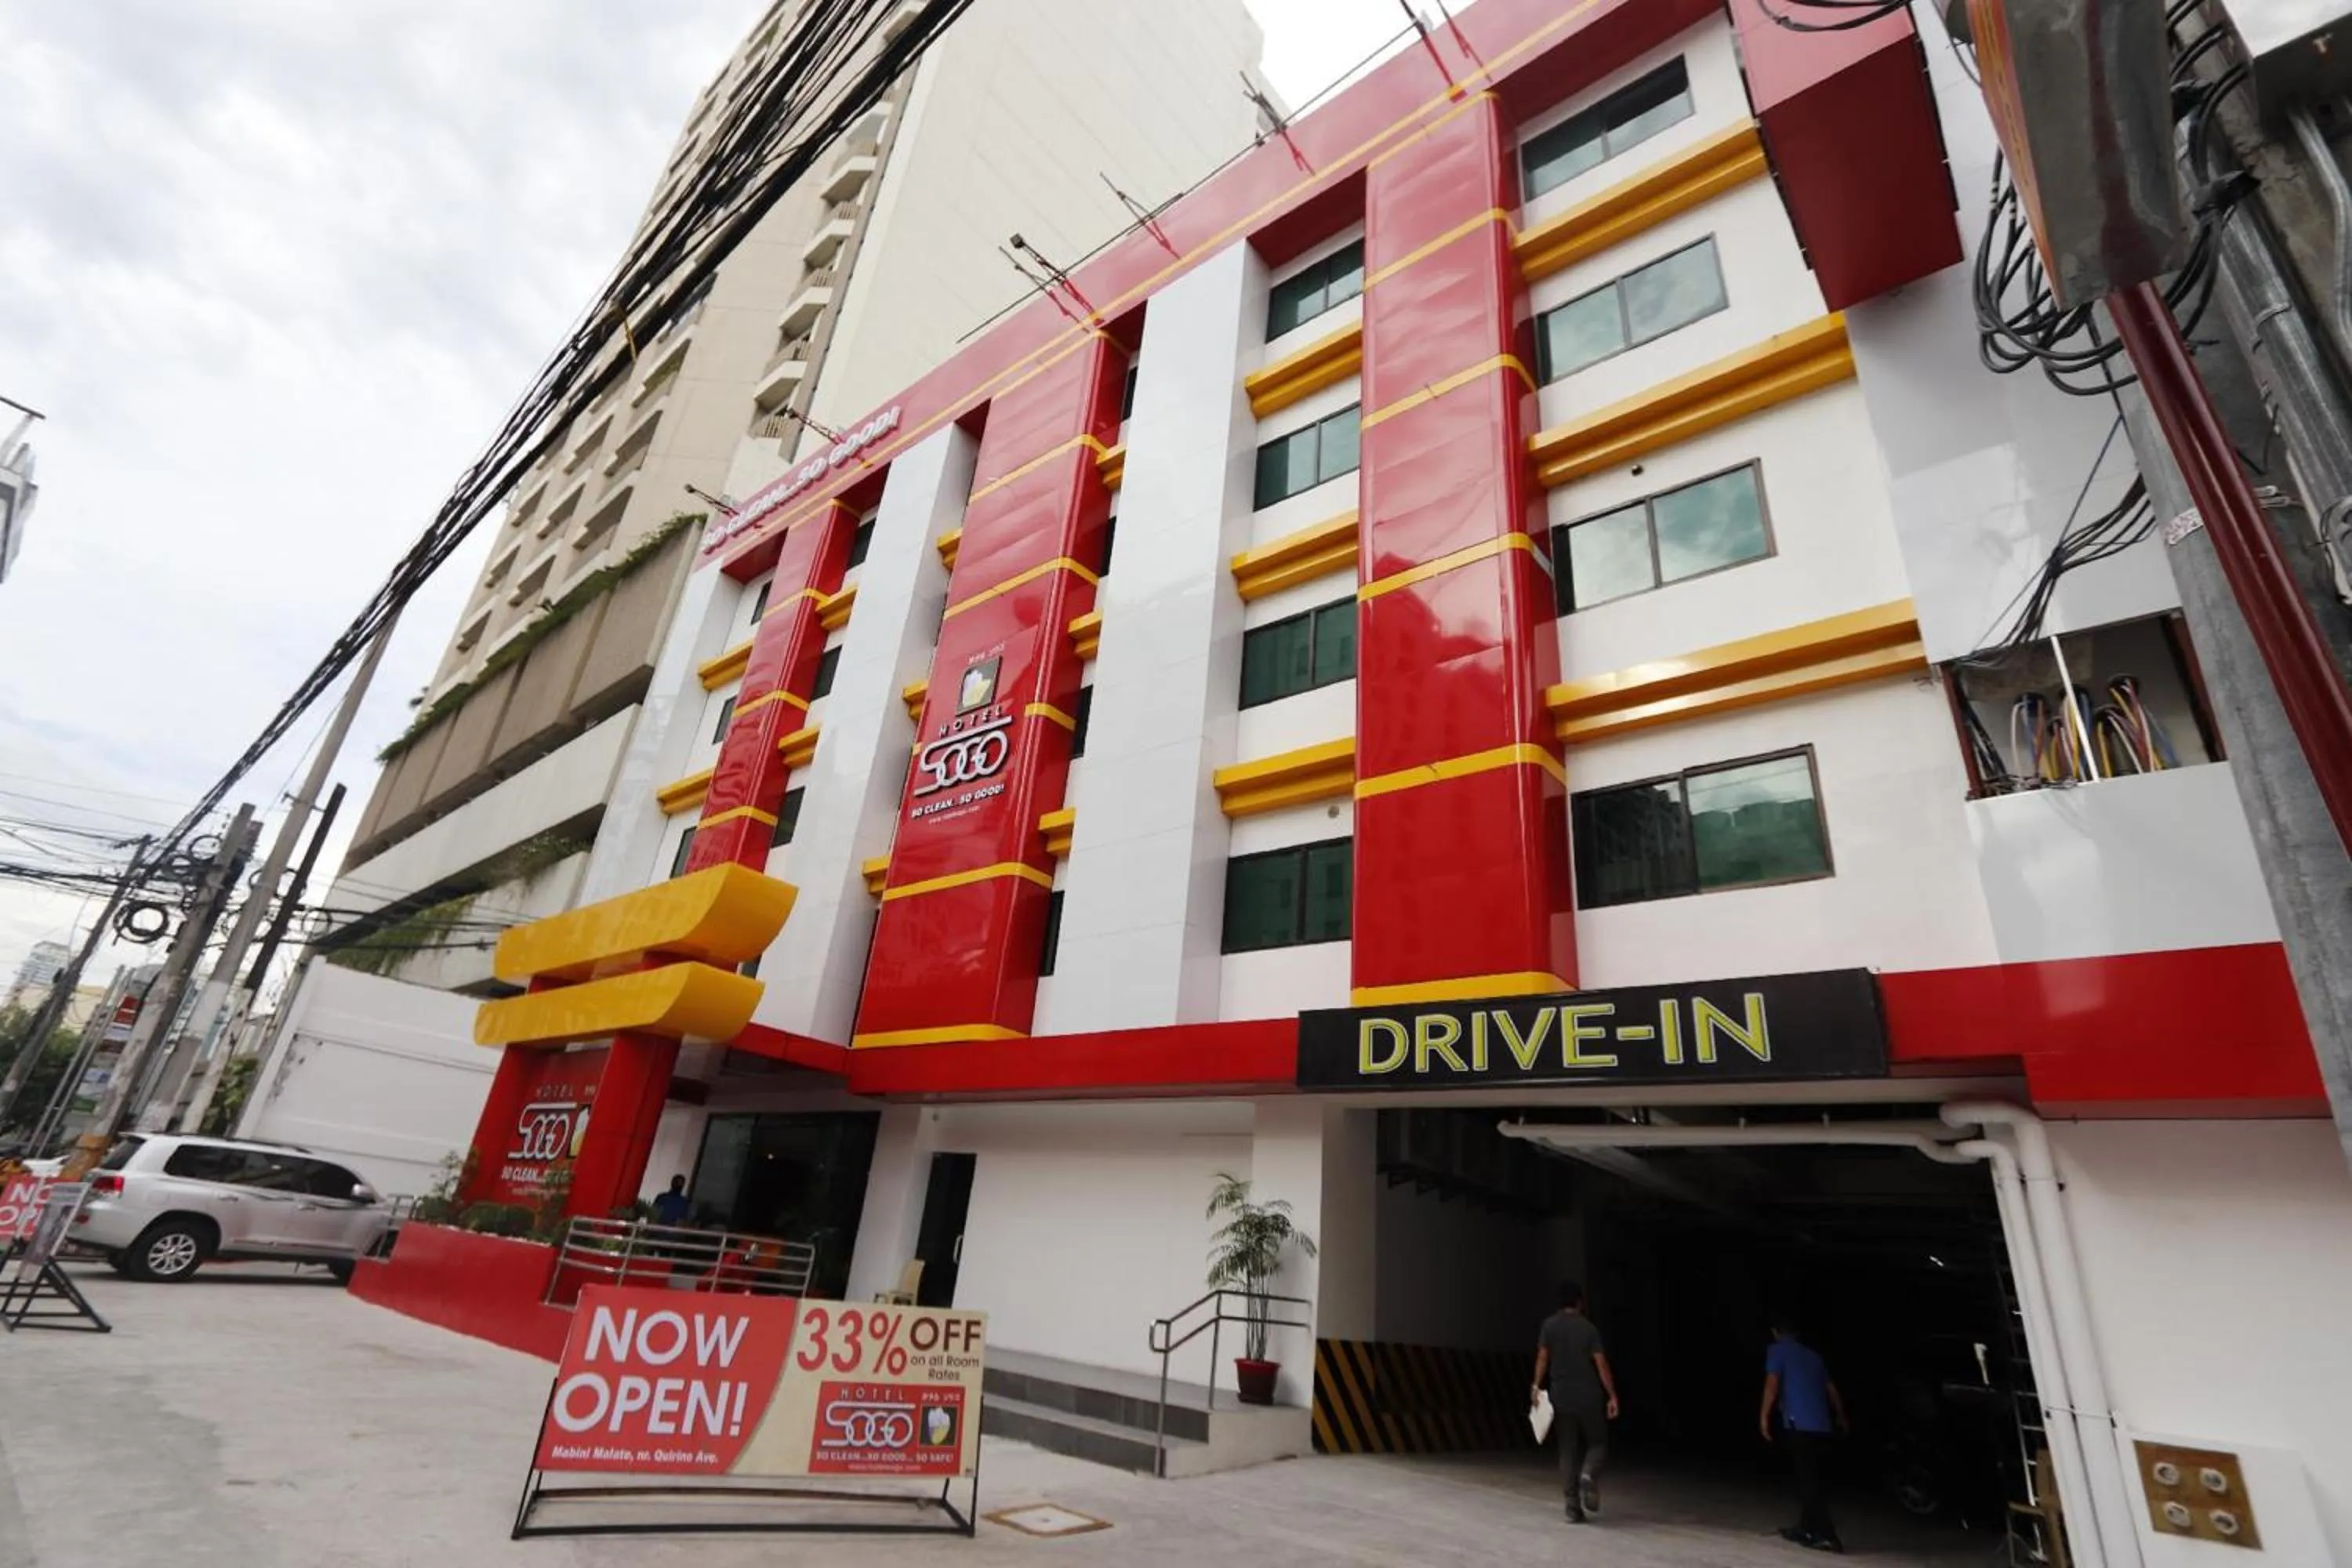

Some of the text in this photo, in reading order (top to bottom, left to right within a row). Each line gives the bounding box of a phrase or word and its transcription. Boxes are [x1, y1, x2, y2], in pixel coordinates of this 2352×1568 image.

[938, 705, 1004, 737] HOTEL
[913, 715, 1013, 797] SOGO
[1357, 992, 1772, 1075] DRIVE-IN
[507, 1102, 577, 1160] SOGO
[8, 1182, 52, 1204] NO
[583, 1305, 750, 1368] NOW
[797, 1308, 982, 1377] 33% OFF
[910, 1355, 980, 1368] on all Room
[928, 1368, 960, 1381] Rates
[552, 1372, 750, 1438] OPEN!
[840, 1387, 904, 1401] HOTEL
[821, 1400, 916, 1448] SOGO
[551, 1445, 719, 1465] Mabini Malate, nr. Quirino Ave.
